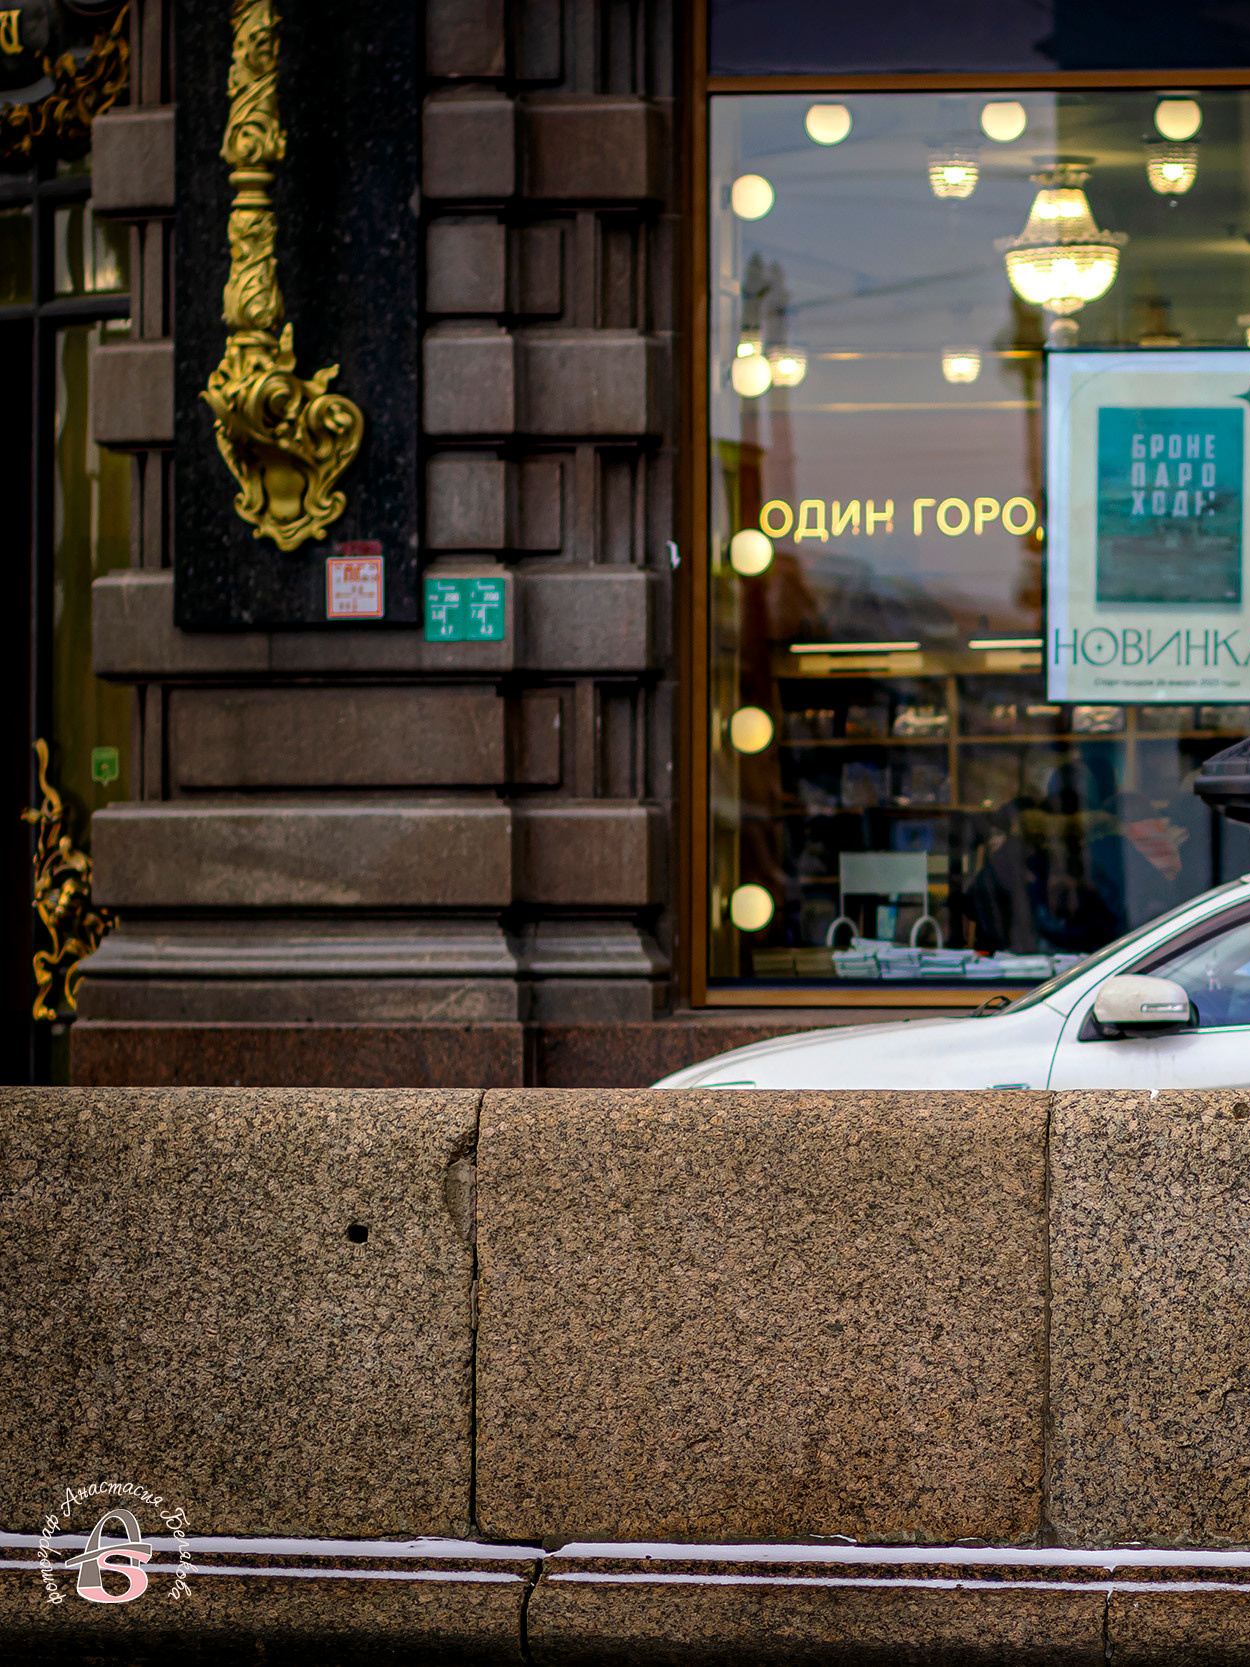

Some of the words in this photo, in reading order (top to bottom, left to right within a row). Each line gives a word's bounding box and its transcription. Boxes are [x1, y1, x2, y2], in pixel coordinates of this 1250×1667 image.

[1132, 433, 1216, 459] БРОНЕ
[1131, 462, 1216, 488] ПАРО
[759, 499, 894, 543] ОДИН
[913, 497, 1045, 541] ГОРО
